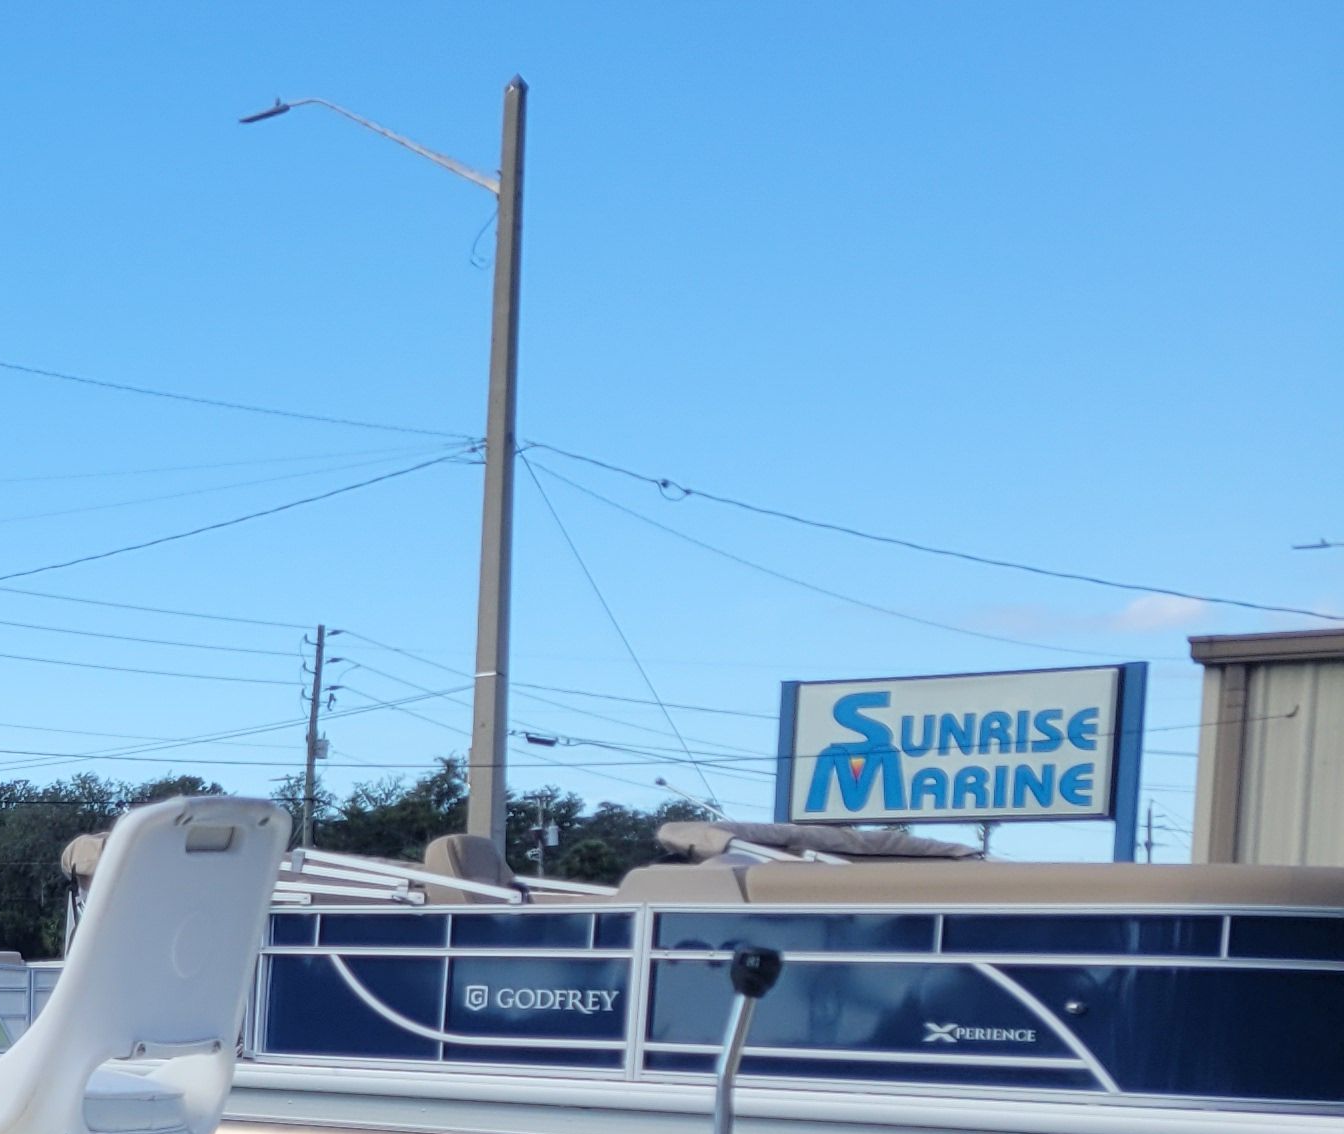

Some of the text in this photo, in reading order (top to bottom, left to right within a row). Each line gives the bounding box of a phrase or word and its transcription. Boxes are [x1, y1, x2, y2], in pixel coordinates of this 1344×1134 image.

[833, 690, 1100, 757] SUNRISE
[804, 744, 1095, 813] MARINE
[496, 988, 619, 1014] GODFREY
[922, 1022, 1037, 1042] XPERIENCE
